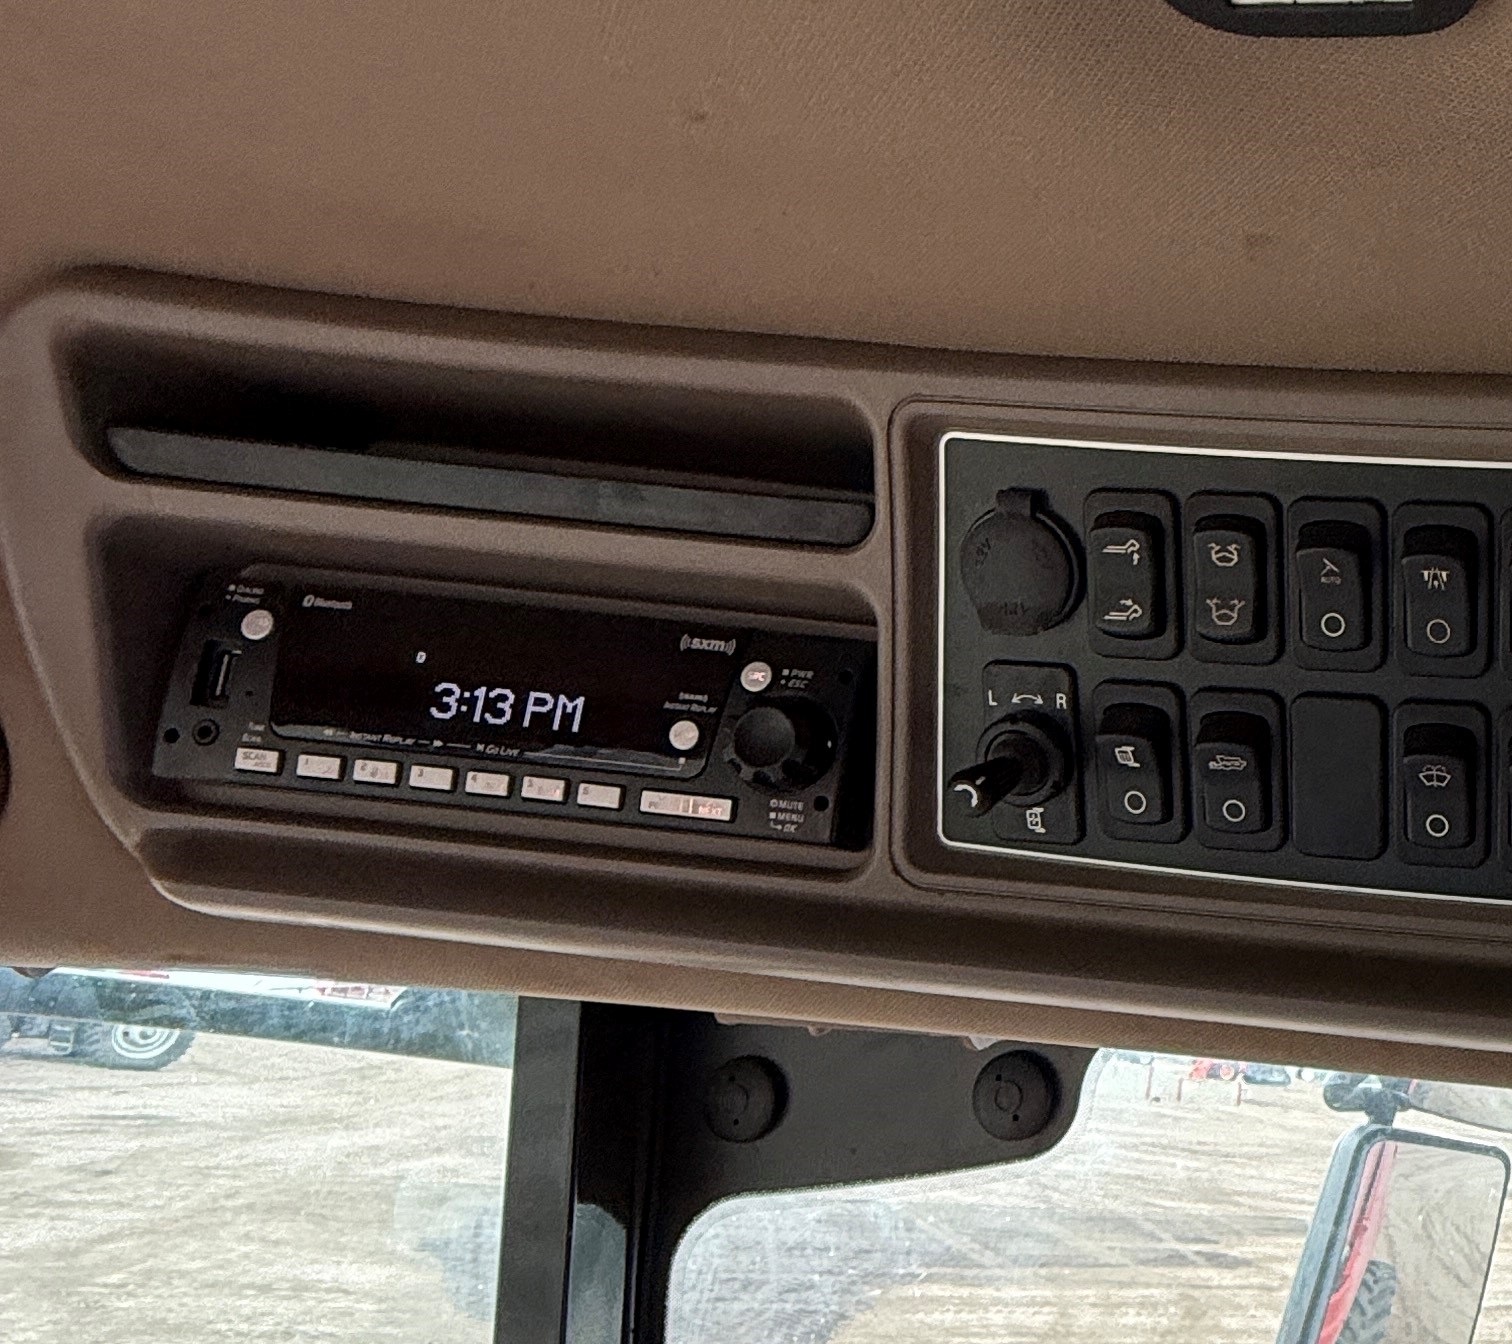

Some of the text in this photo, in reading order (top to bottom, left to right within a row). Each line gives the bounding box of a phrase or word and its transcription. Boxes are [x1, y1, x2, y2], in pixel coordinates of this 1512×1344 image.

[987, 689, 1067, 709] L R
[429, 682, 586, 733] 3:13 PM
[779, 799, 804, 811] MUTE
[777, 812, 804, 823] MENU
